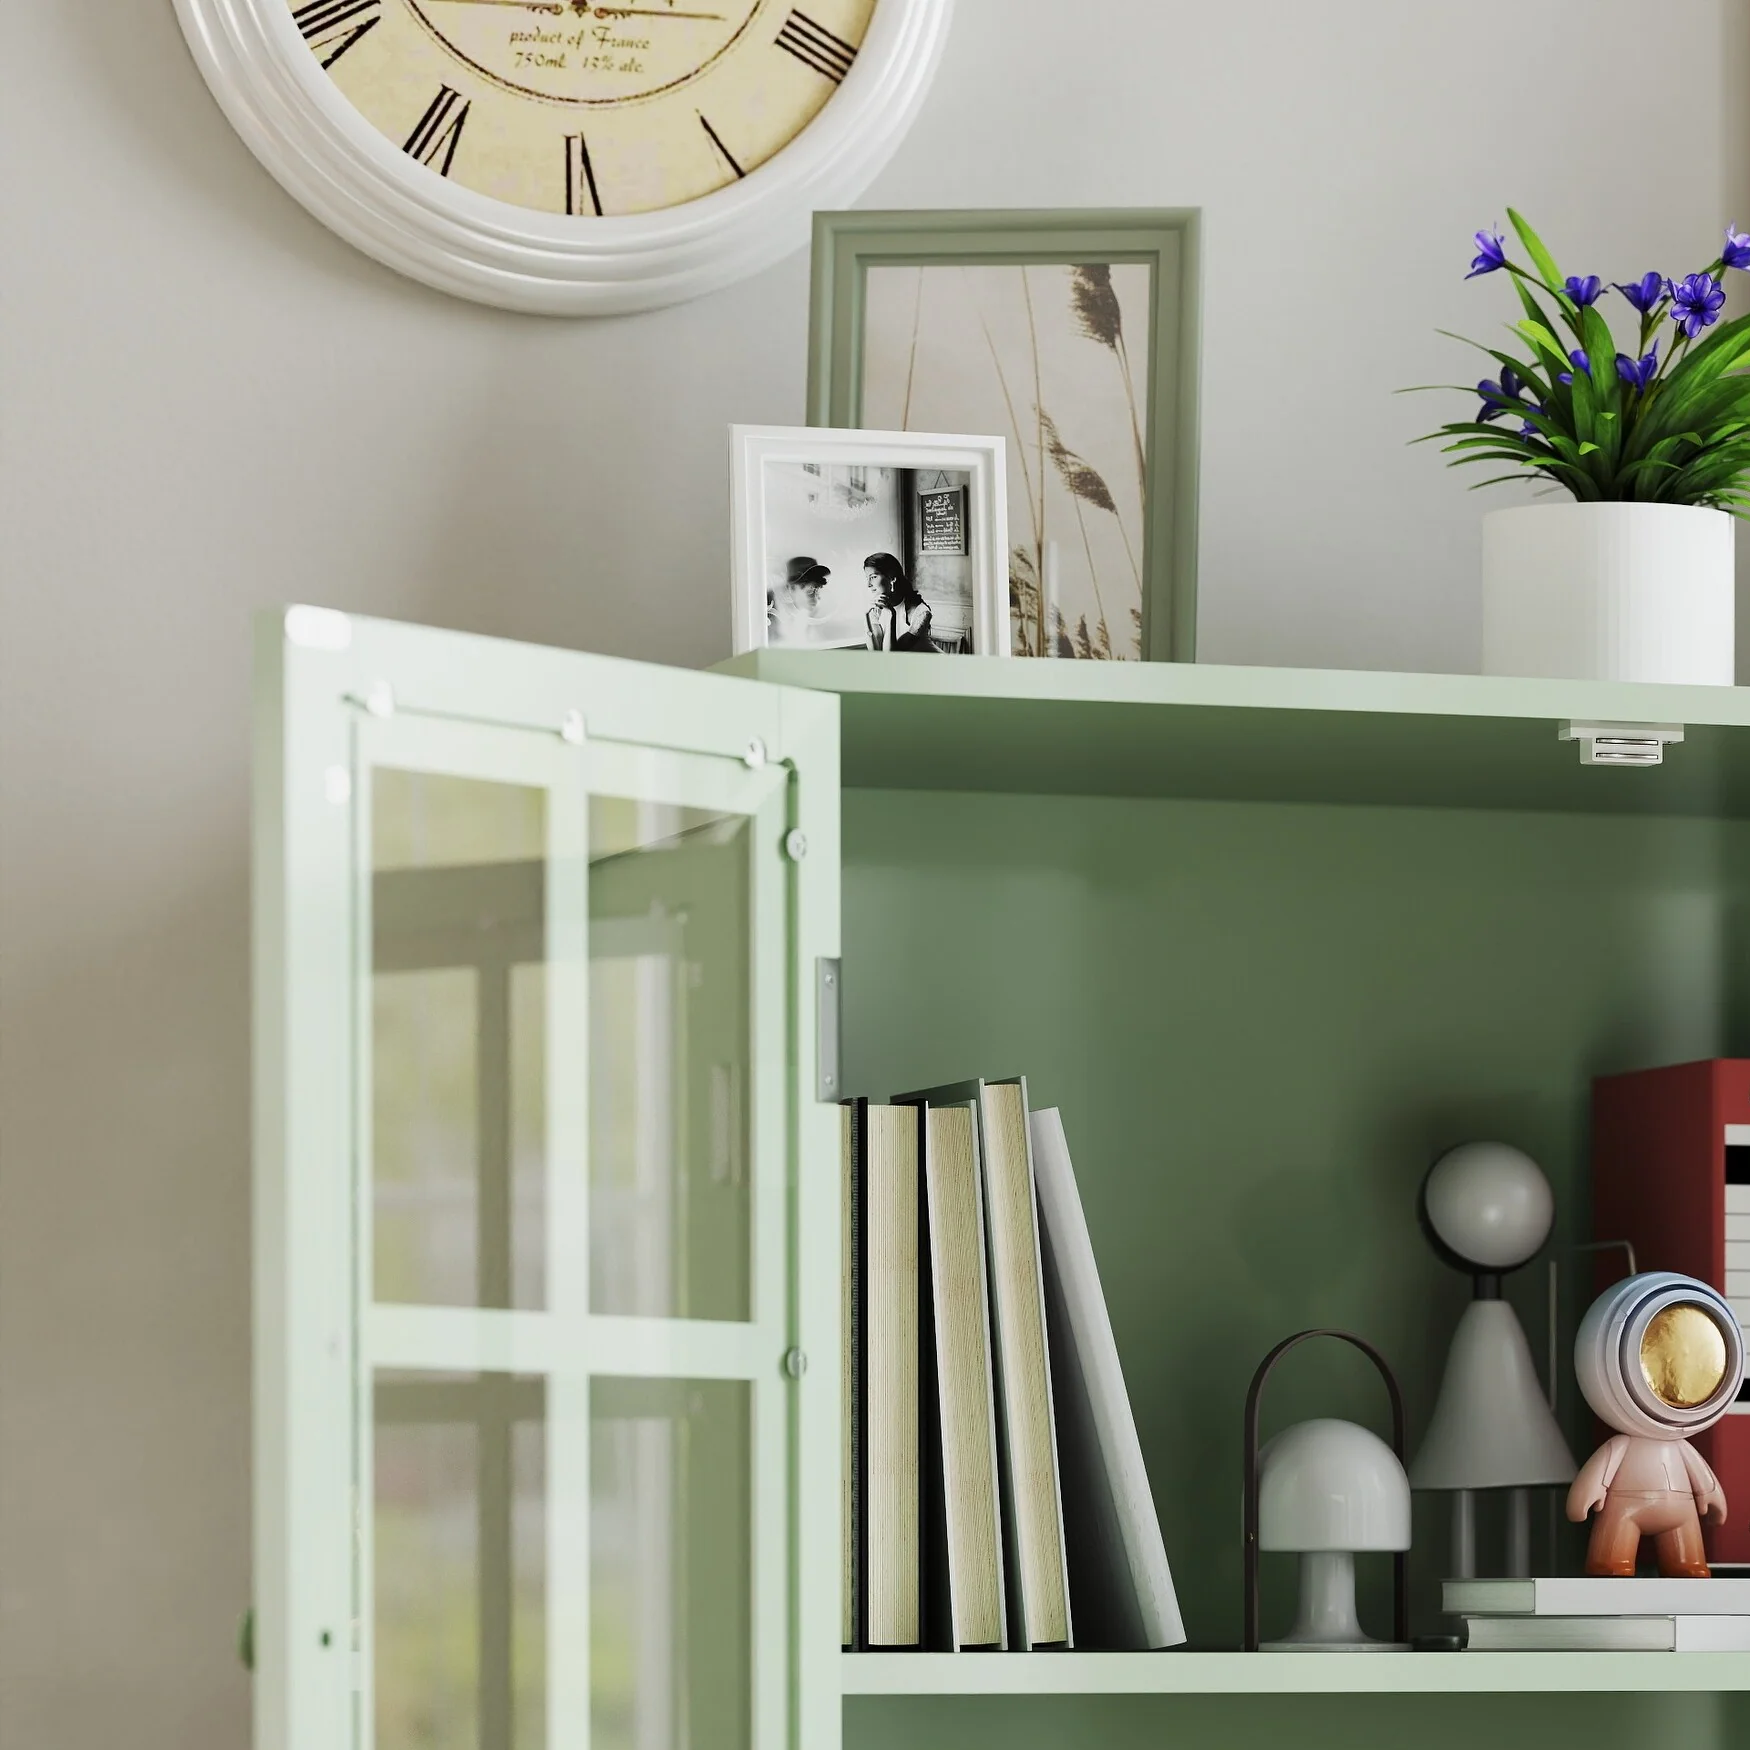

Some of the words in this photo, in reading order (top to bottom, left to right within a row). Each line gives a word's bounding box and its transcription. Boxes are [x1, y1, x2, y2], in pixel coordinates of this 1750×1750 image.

[509, 26, 562, 46] product
[567, 29, 585, 50] of
[592, 26, 650, 49] France
